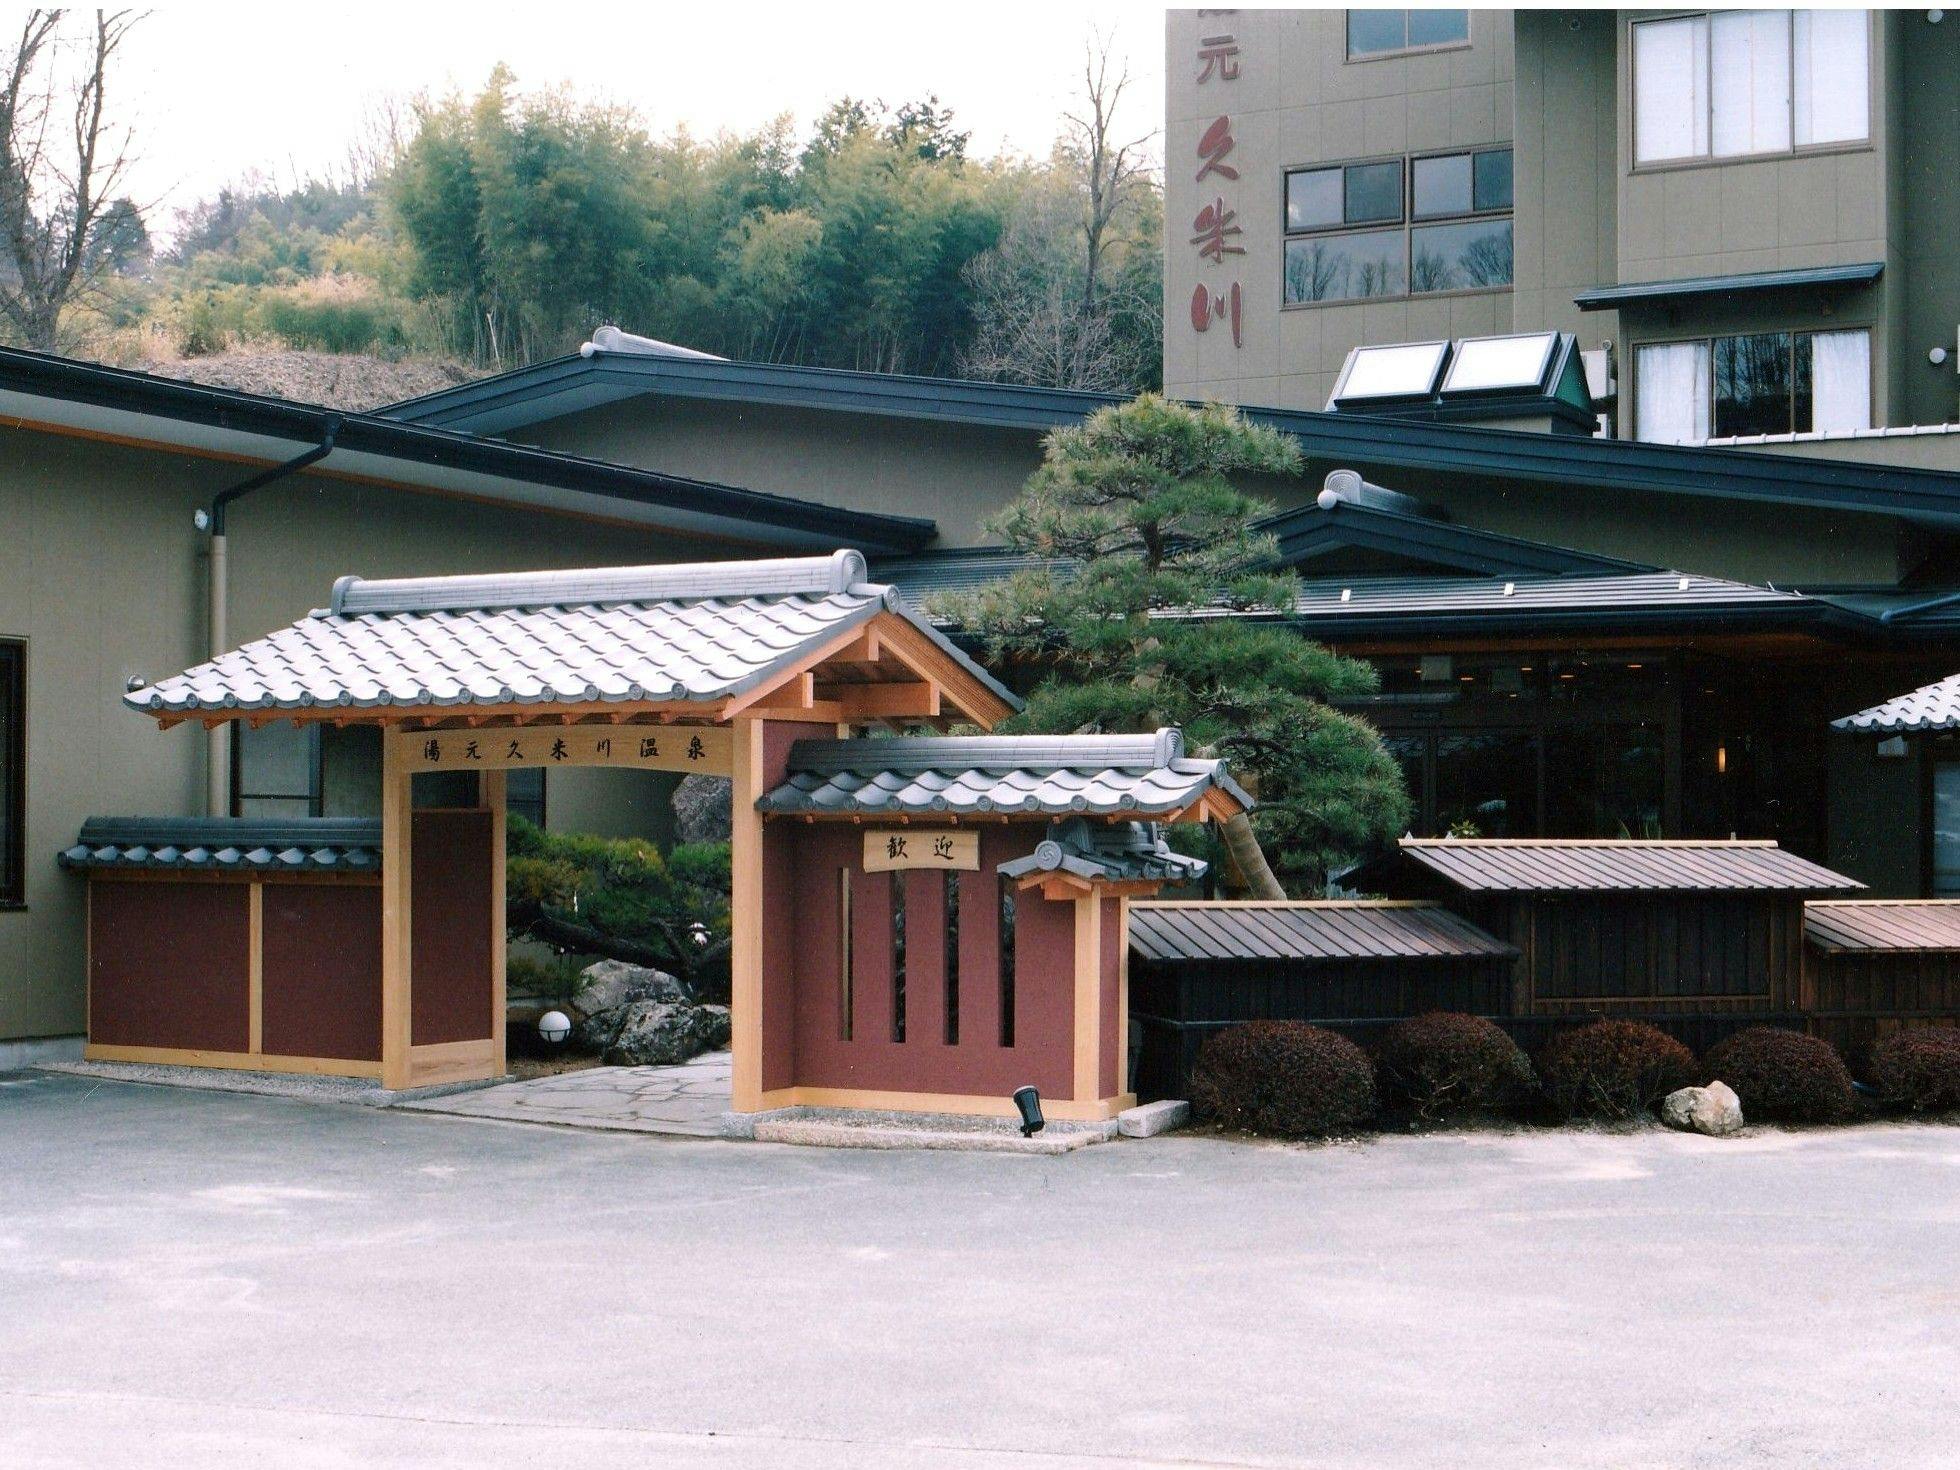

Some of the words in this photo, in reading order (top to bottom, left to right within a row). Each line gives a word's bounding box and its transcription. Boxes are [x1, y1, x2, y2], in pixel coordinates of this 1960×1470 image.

[1191, 9, 1246, 348] 元久米川
[424, 736, 705, 762] 湯元久米川温泉
[886, 835, 954, 860] 歓迎
